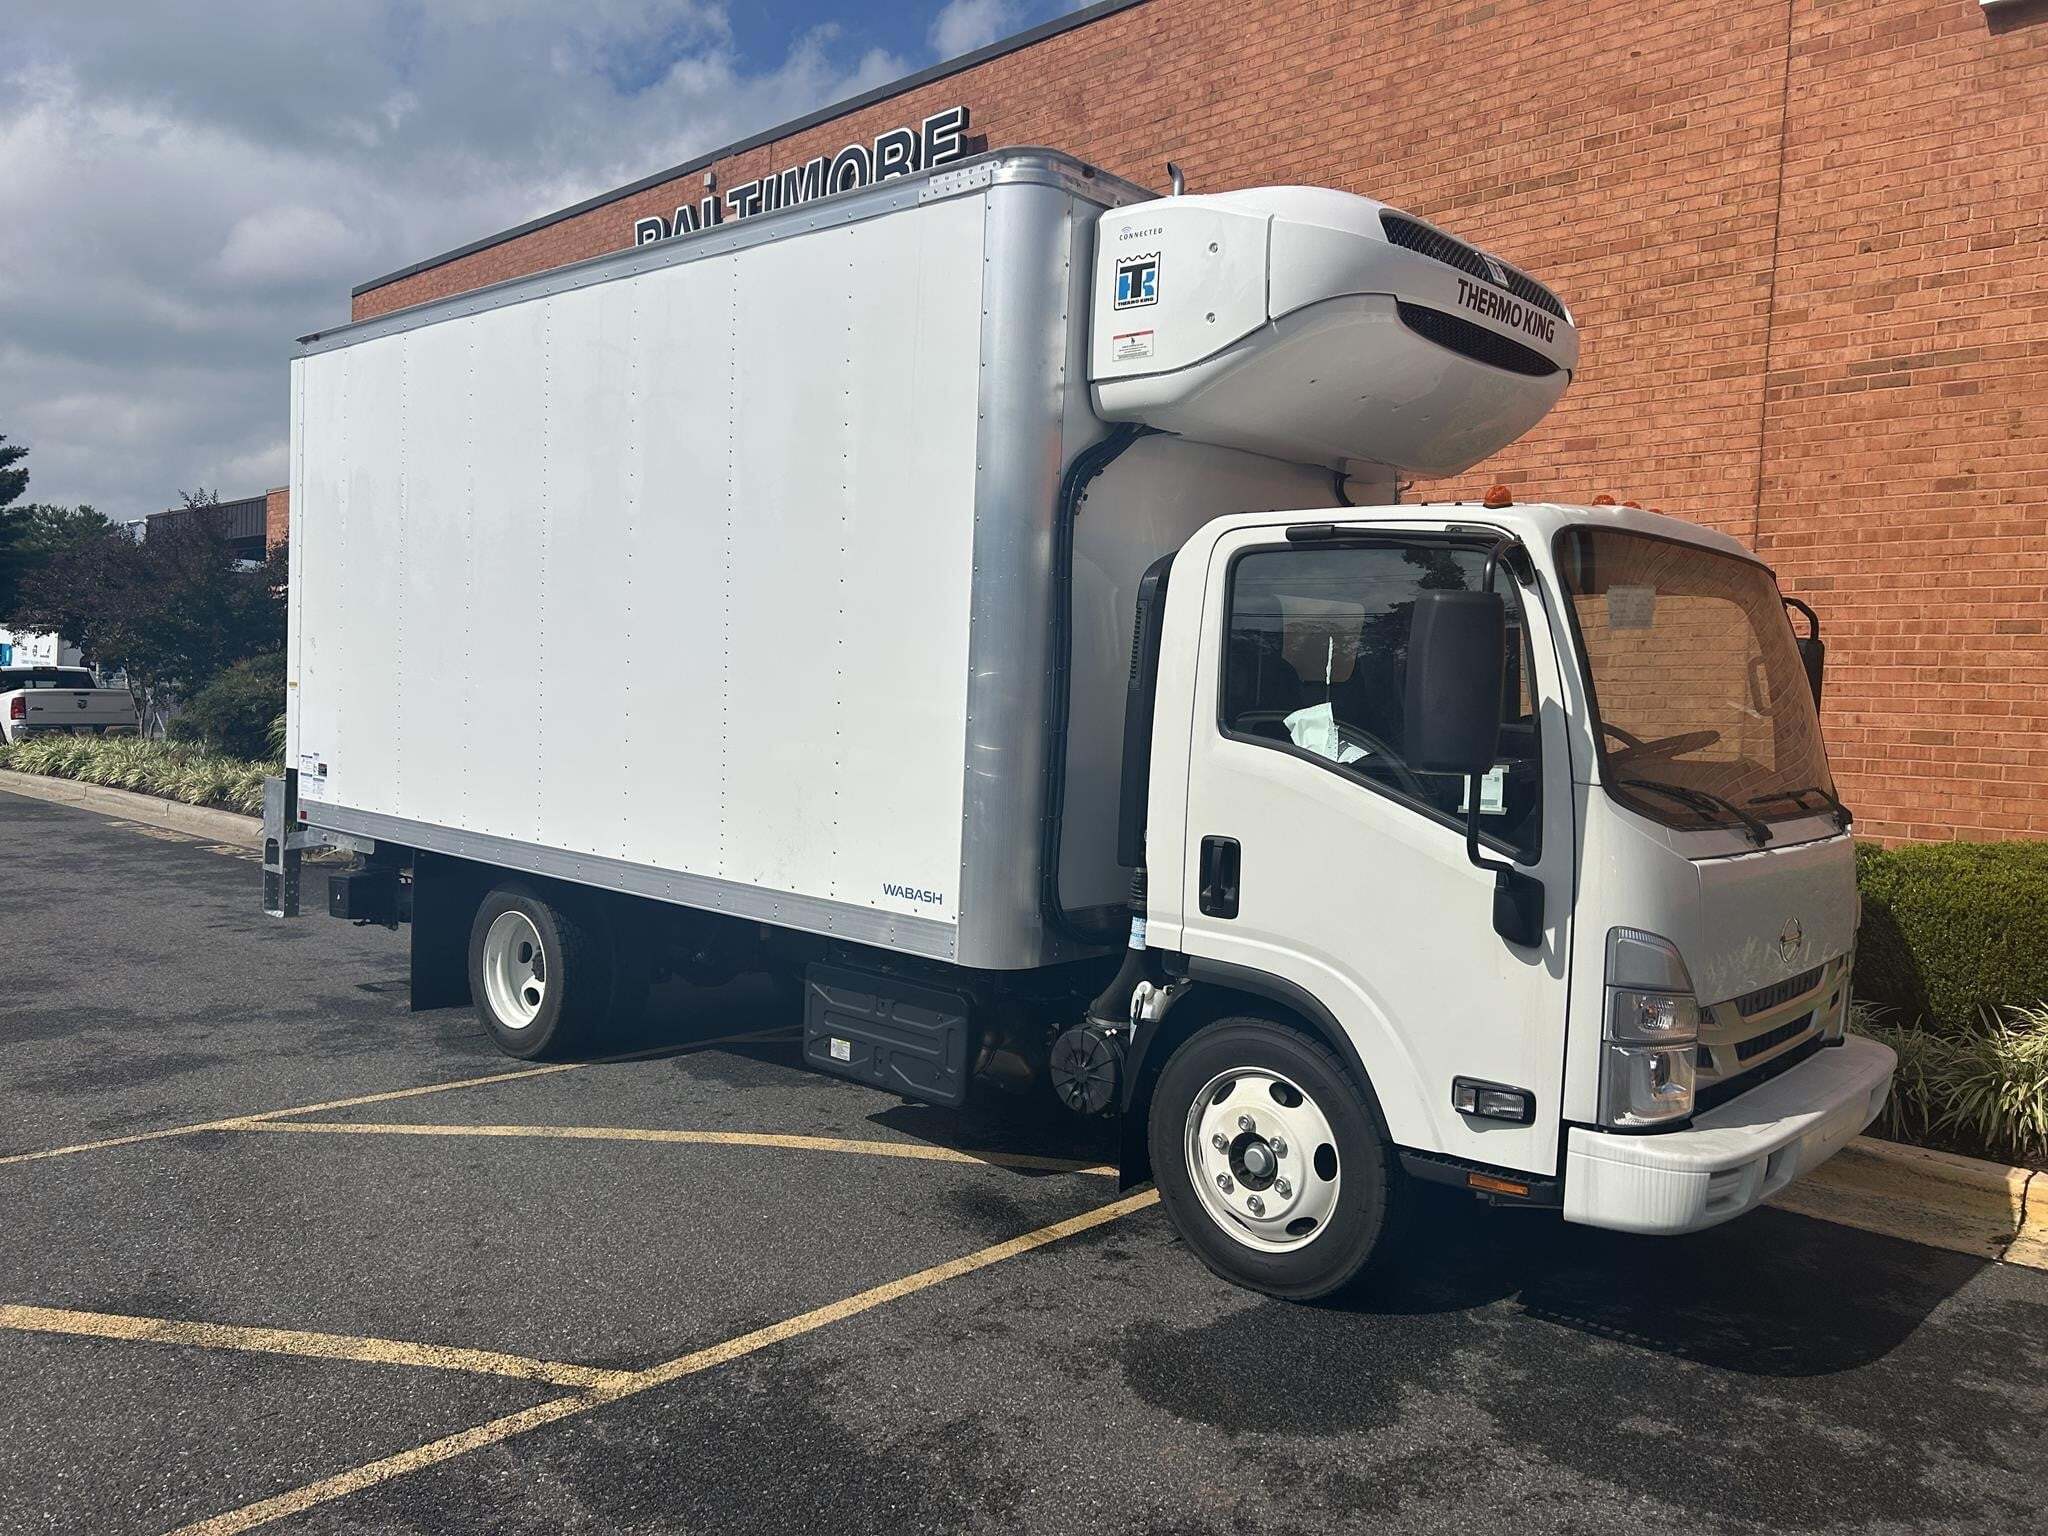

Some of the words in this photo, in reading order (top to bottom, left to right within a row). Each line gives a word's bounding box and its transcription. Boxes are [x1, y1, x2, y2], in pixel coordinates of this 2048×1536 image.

[1119, 227, 1163, 241] CONNECTED
[1458, 278, 1522, 327] THERMO
[1522, 308, 1555, 343] KING
[883, 883, 943, 905] WABASH
